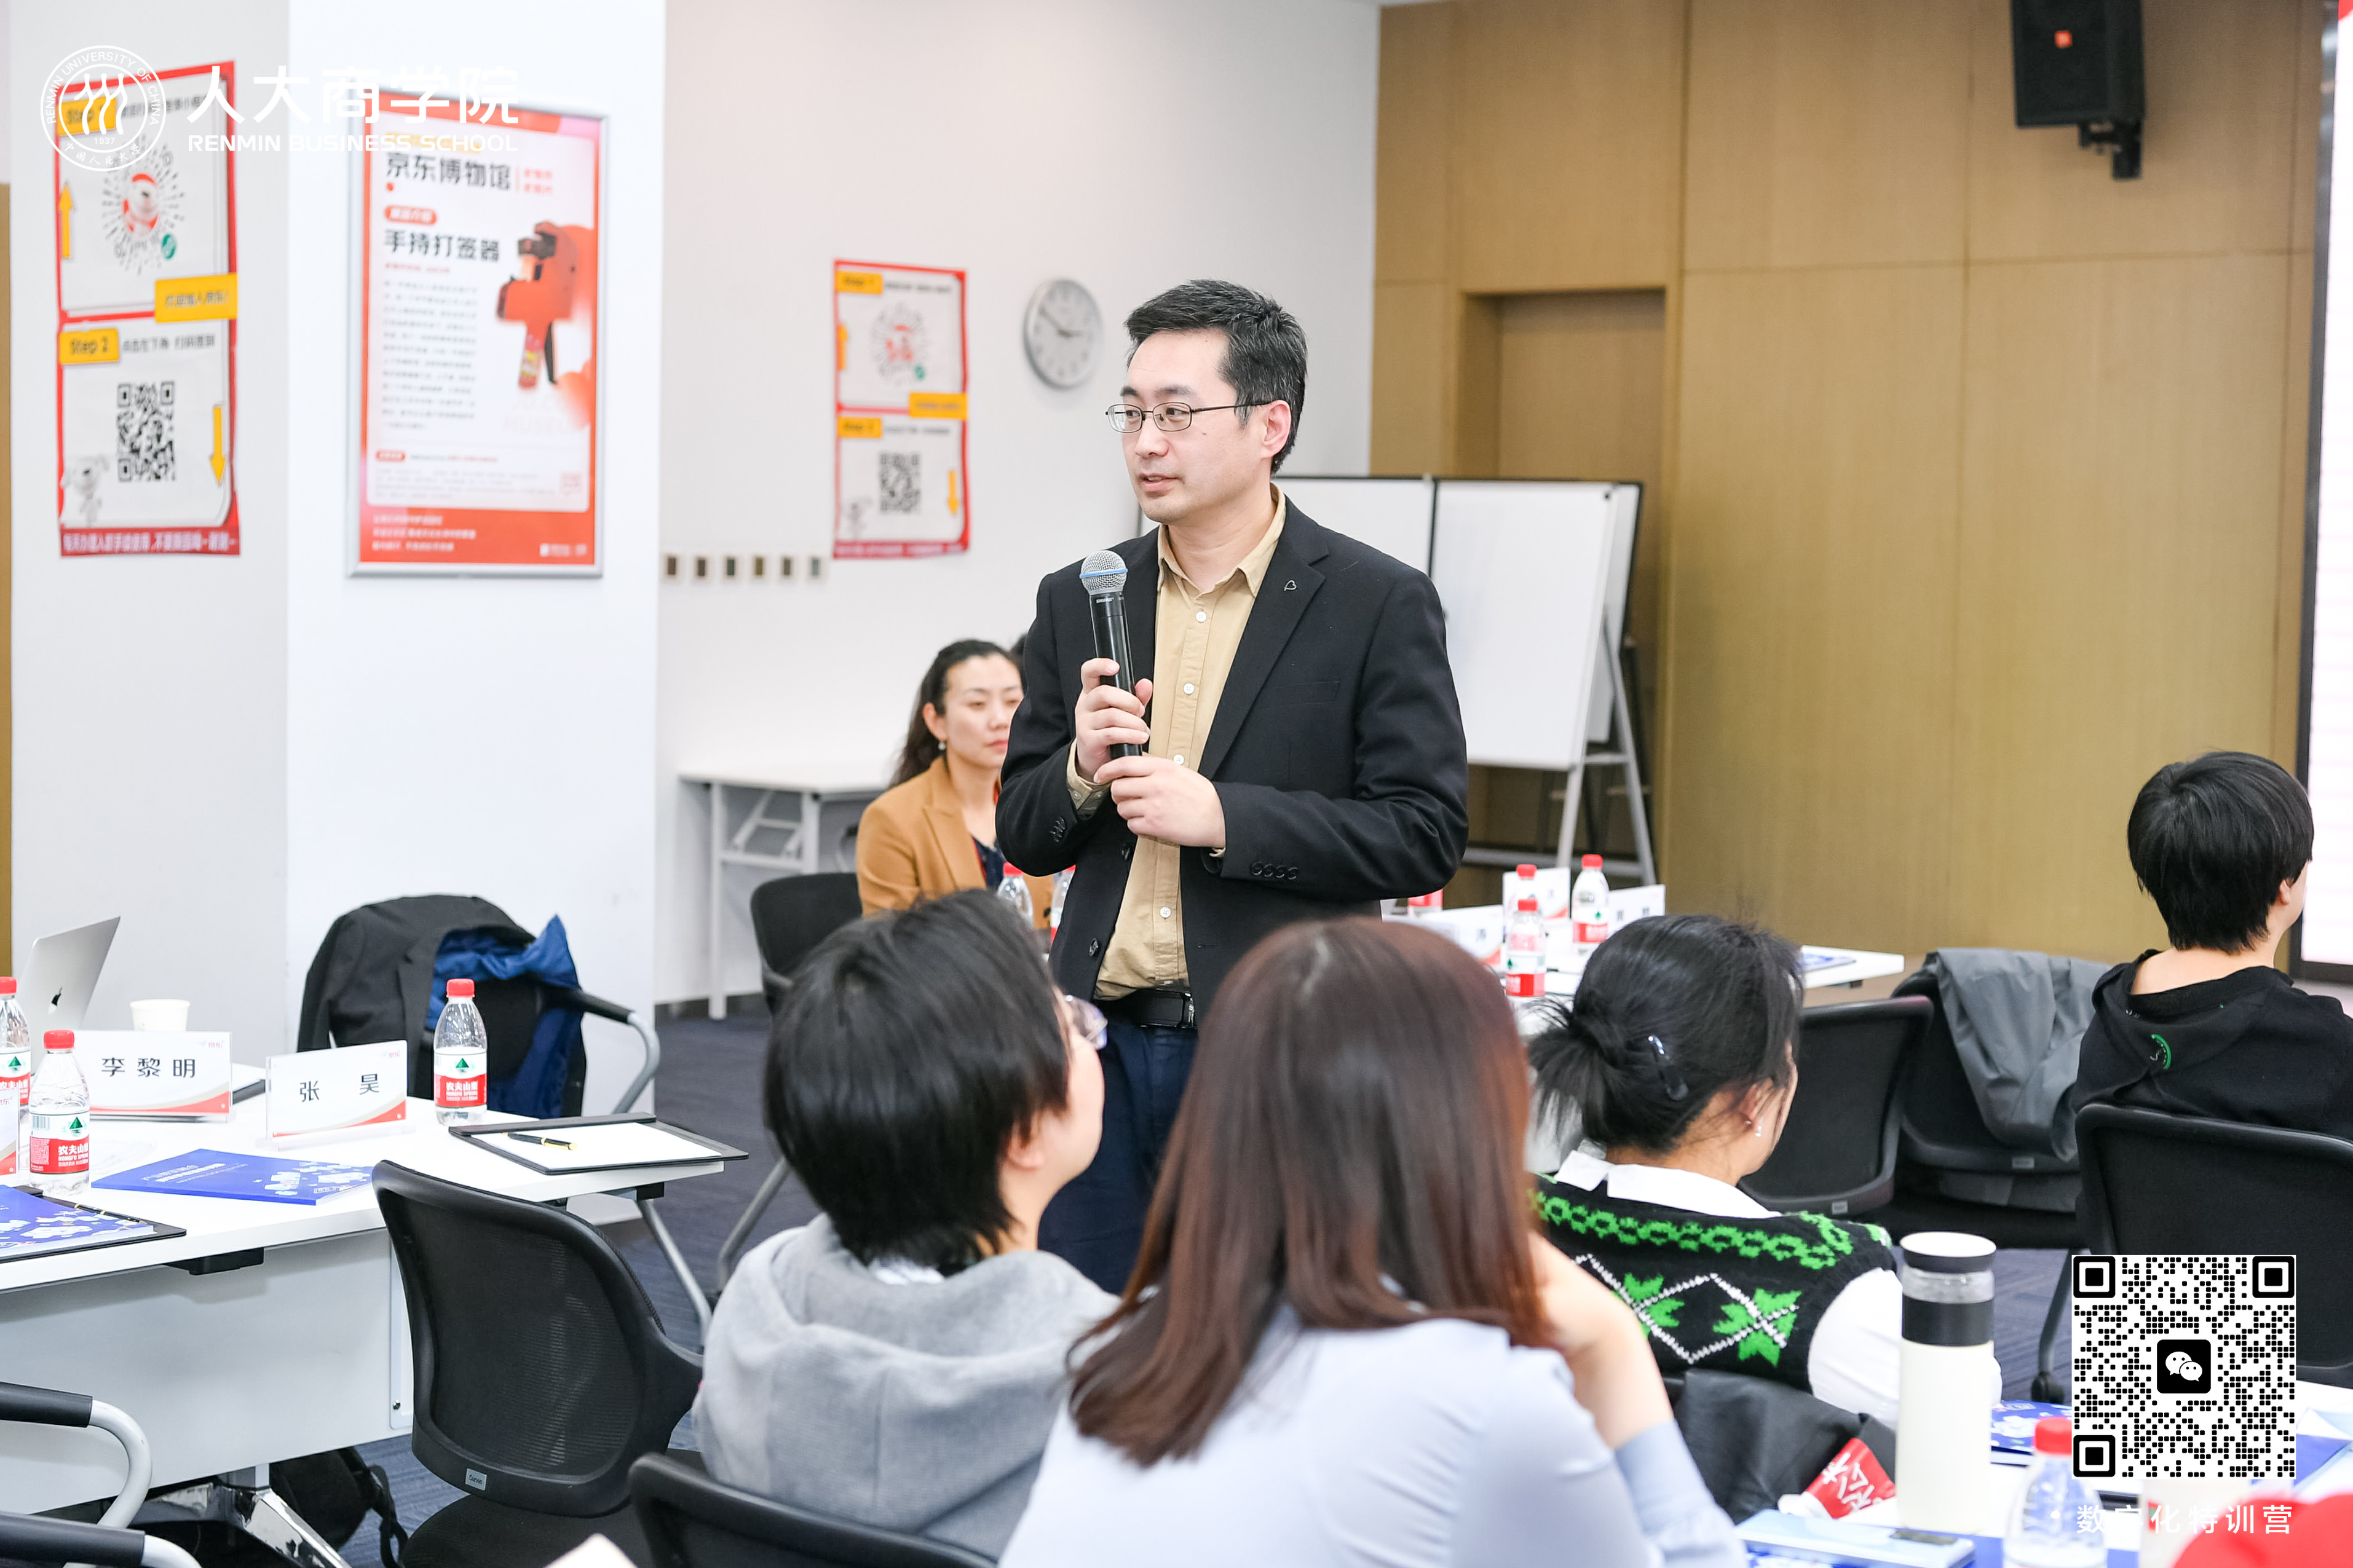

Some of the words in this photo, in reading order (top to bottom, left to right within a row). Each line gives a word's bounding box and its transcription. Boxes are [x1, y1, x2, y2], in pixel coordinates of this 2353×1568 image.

[386, 152, 512, 191] 京东博物馆
[384, 229, 499, 261] 手持打签器
[69, 339, 98, 355] Step
[101, 1057, 196, 1079] 李黎明
